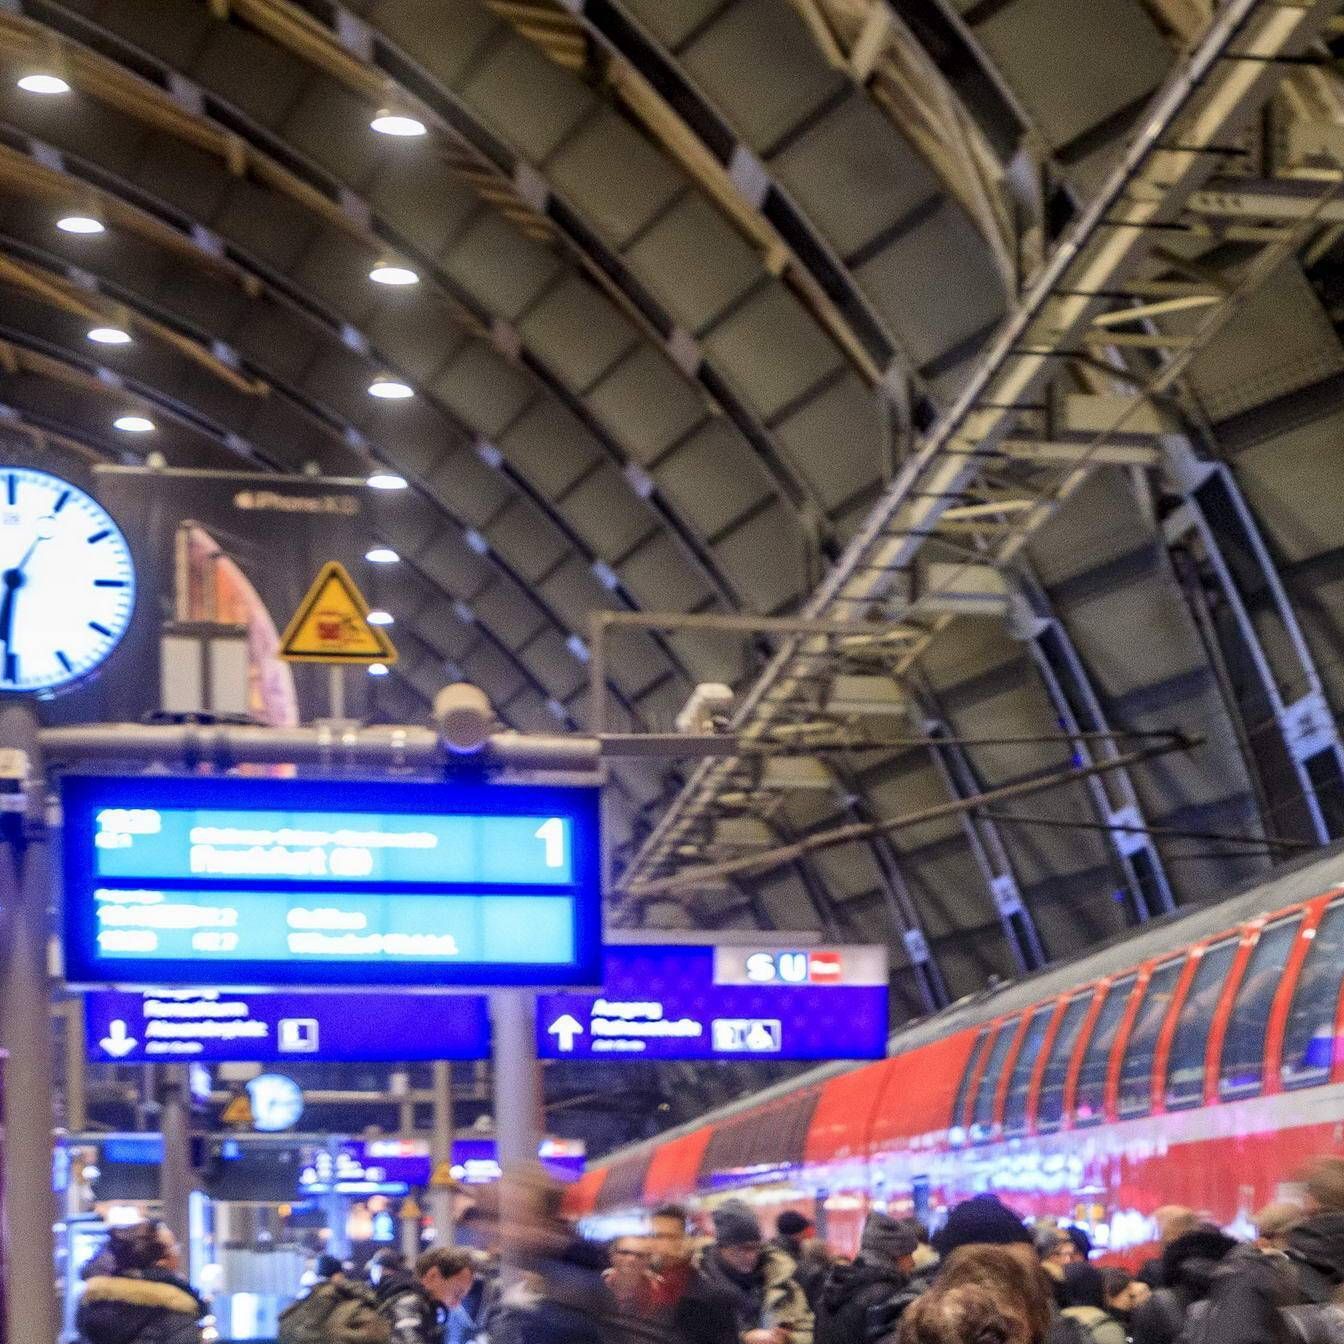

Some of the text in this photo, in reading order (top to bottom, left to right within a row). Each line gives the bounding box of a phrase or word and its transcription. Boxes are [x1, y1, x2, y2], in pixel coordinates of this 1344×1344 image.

[534, 818, 563, 868] 1
[747, 953, 775, 981] S
[780, 953, 806, 981] U
